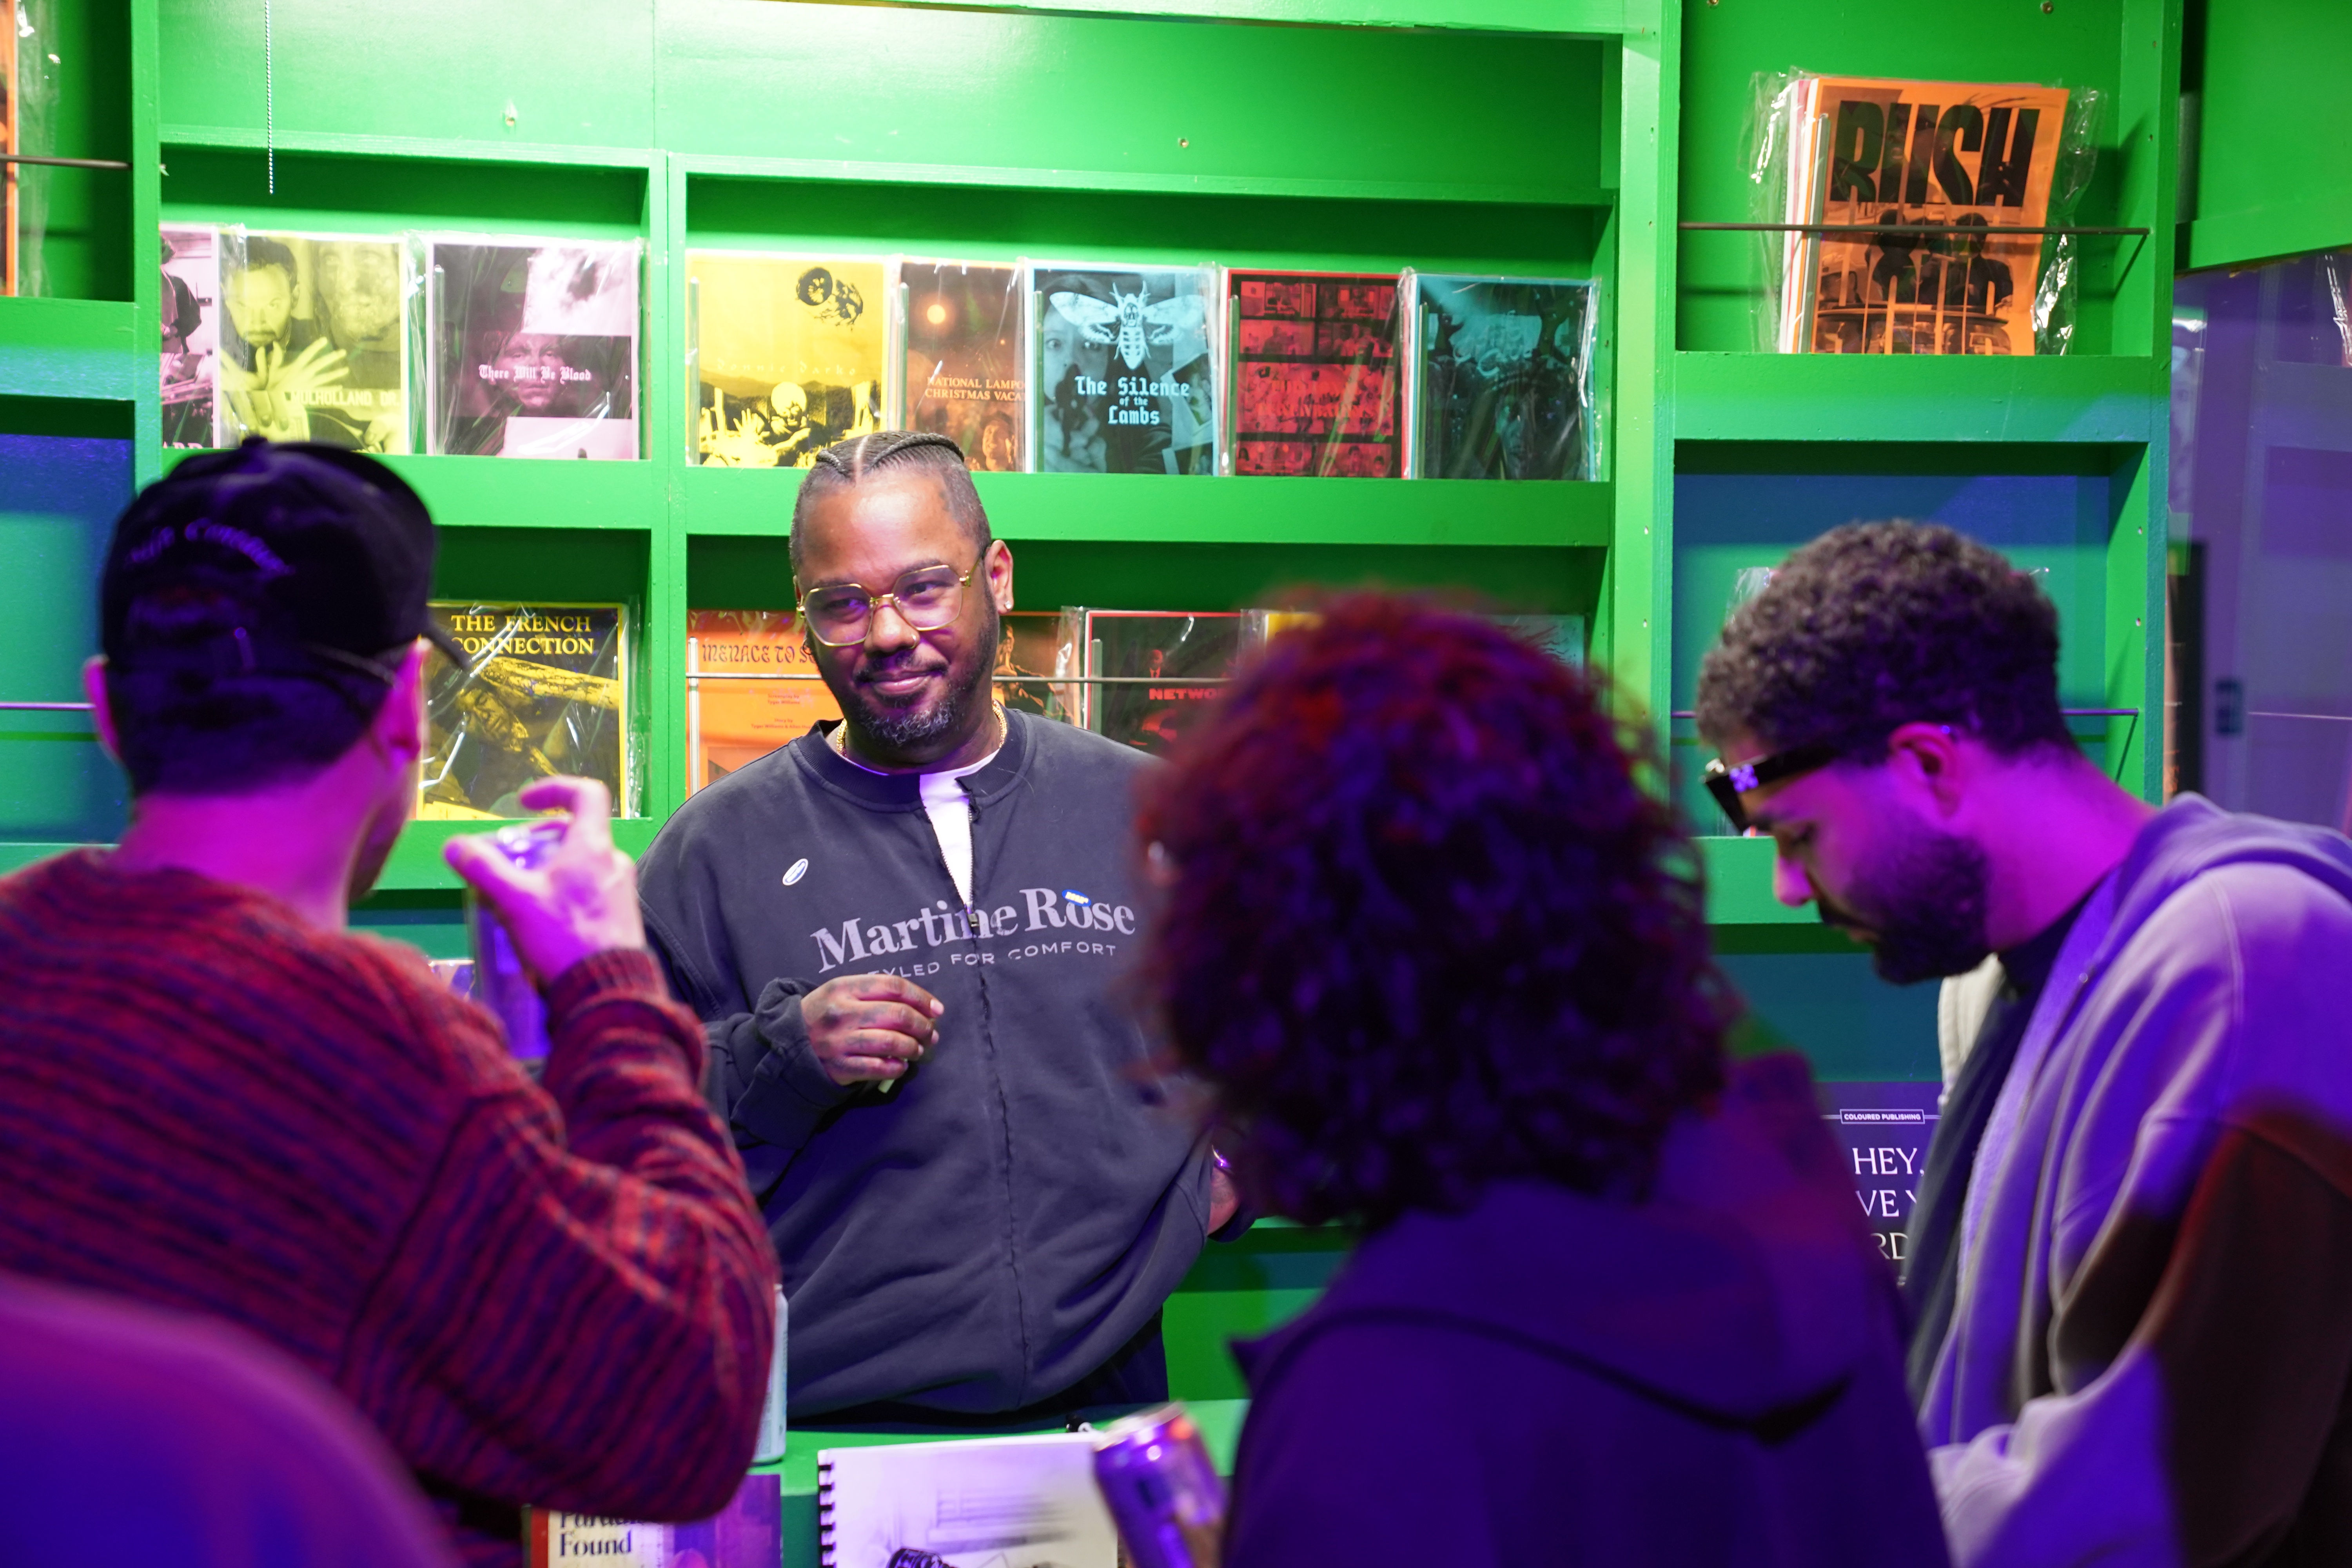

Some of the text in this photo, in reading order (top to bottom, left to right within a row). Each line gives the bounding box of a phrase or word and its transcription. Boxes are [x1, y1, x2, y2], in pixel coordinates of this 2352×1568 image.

[1830, 100, 2041, 207] RUSH
[479, 364, 592, 384] There Will Be Blood
[799, 360, 855, 375] Darko
[927, 377, 1025, 389] NATIONAL LAMPO
[1074, 376, 1190, 397] The Silence
[291, 390, 372, 406] MULHOLLAND
[925, 388, 1025, 401] CHRISTMAS VACA
[1119, 396, 1149, 407] of the
[1108, 405, 1160, 425] Lambs
[451, 615, 591, 632] THE FRENCH
[702, 644, 770, 663] MENACE
[775, 646, 795, 663] TO
[810, 888, 1135, 973] Martine Rose
[951, 953, 995, 965] FOR
[1008, 941, 1116, 960] COMFORT
[1852, 1148, 1925, 1176] HEY,
[560, 1530, 632, 1557] Found
